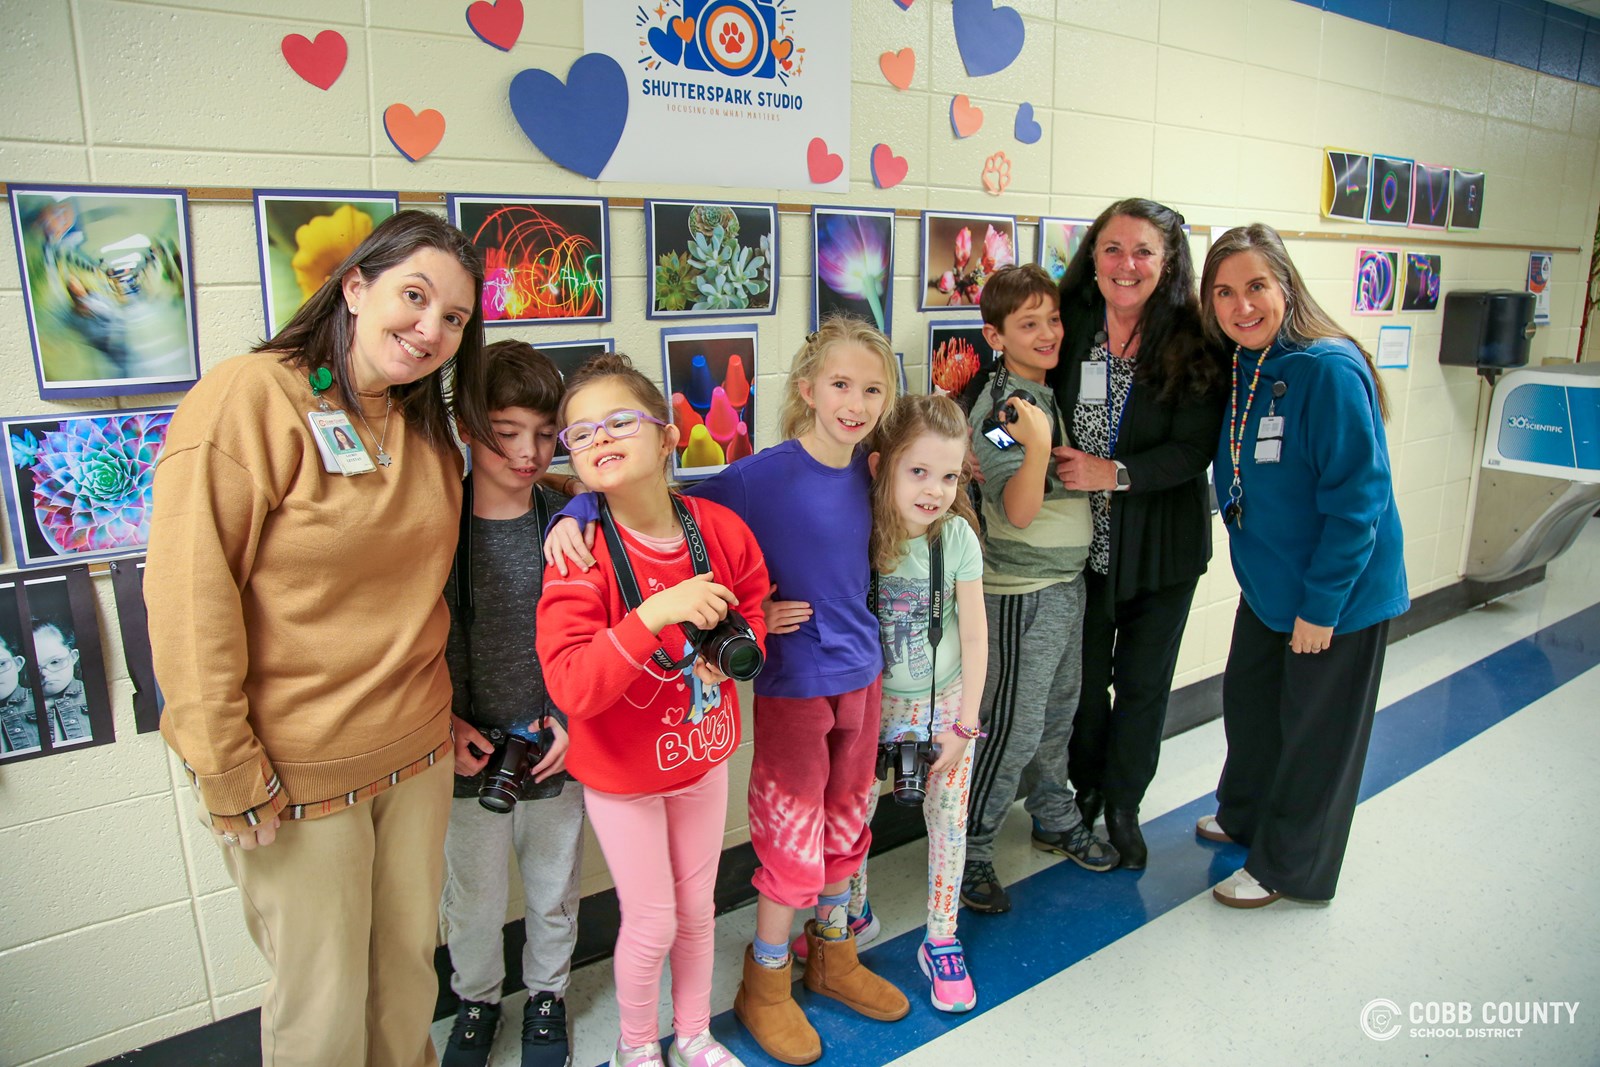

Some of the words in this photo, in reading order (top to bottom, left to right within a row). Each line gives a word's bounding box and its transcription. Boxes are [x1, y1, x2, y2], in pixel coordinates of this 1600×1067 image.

[642, 79, 753, 106] SHUTTERSPARK
[757, 91, 803, 110] STUDIO
[710, 107, 720, 116] ON
[722, 109, 744, 118] WHAT
[681, 513, 704, 562] COOLPIX
[933, 590, 941, 619] Nikon
